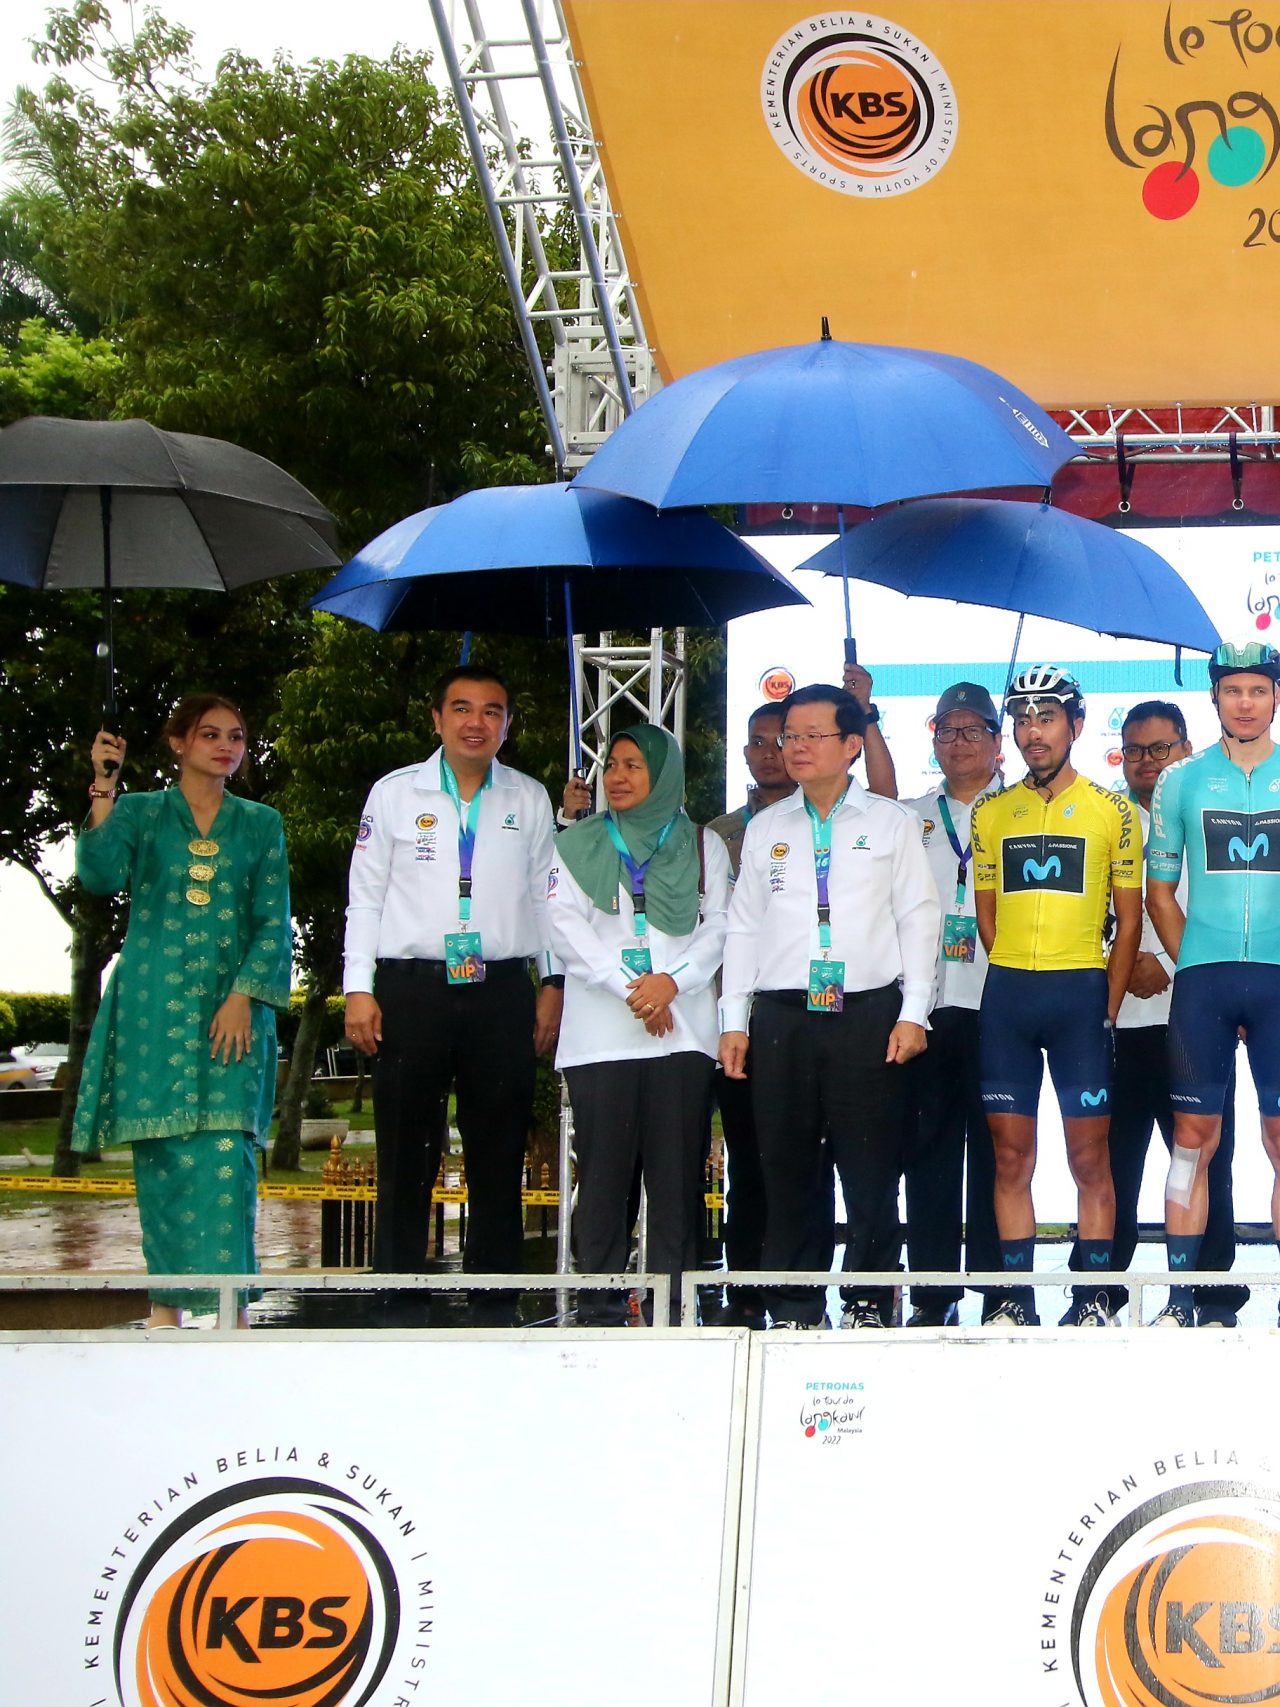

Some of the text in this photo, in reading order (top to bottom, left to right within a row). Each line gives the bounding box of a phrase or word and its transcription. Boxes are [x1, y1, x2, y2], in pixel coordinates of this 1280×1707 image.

[809, 16, 855, 32] BELIA
[865, 19, 874, 28] &
[883, 25, 929, 63] SUKAN
[767, 30, 804, 129] KEMENTERIAN
[830, 91, 908, 125] KBS
[937, 82, 953, 154] MINISTRY
[793, 152, 847, 189] SPORTS
[924, 157, 938, 174] OF
[874, 174, 920, 193] YOUTH
[1088, 781, 1133, 850] PETRONAS
[944, 944, 969, 958] VIP
[449, 965, 476, 979] VIP
[810, 992, 836, 1006] VIP
[806, 1382, 865, 1391] PETRONAS
[84, 1472, 199, 1669] KEMENTERIAN
[216, 1446, 299, 1473] BELIA
[318, 1452, 331, 1468] &
[346, 1464, 417, 1538] SUKAN
[1040, 1474, 1138, 1673] KEMENTERIAN
[1154, 1449, 1239, 1476] BELIA
[205, 1596, 351, 1664] KBS
